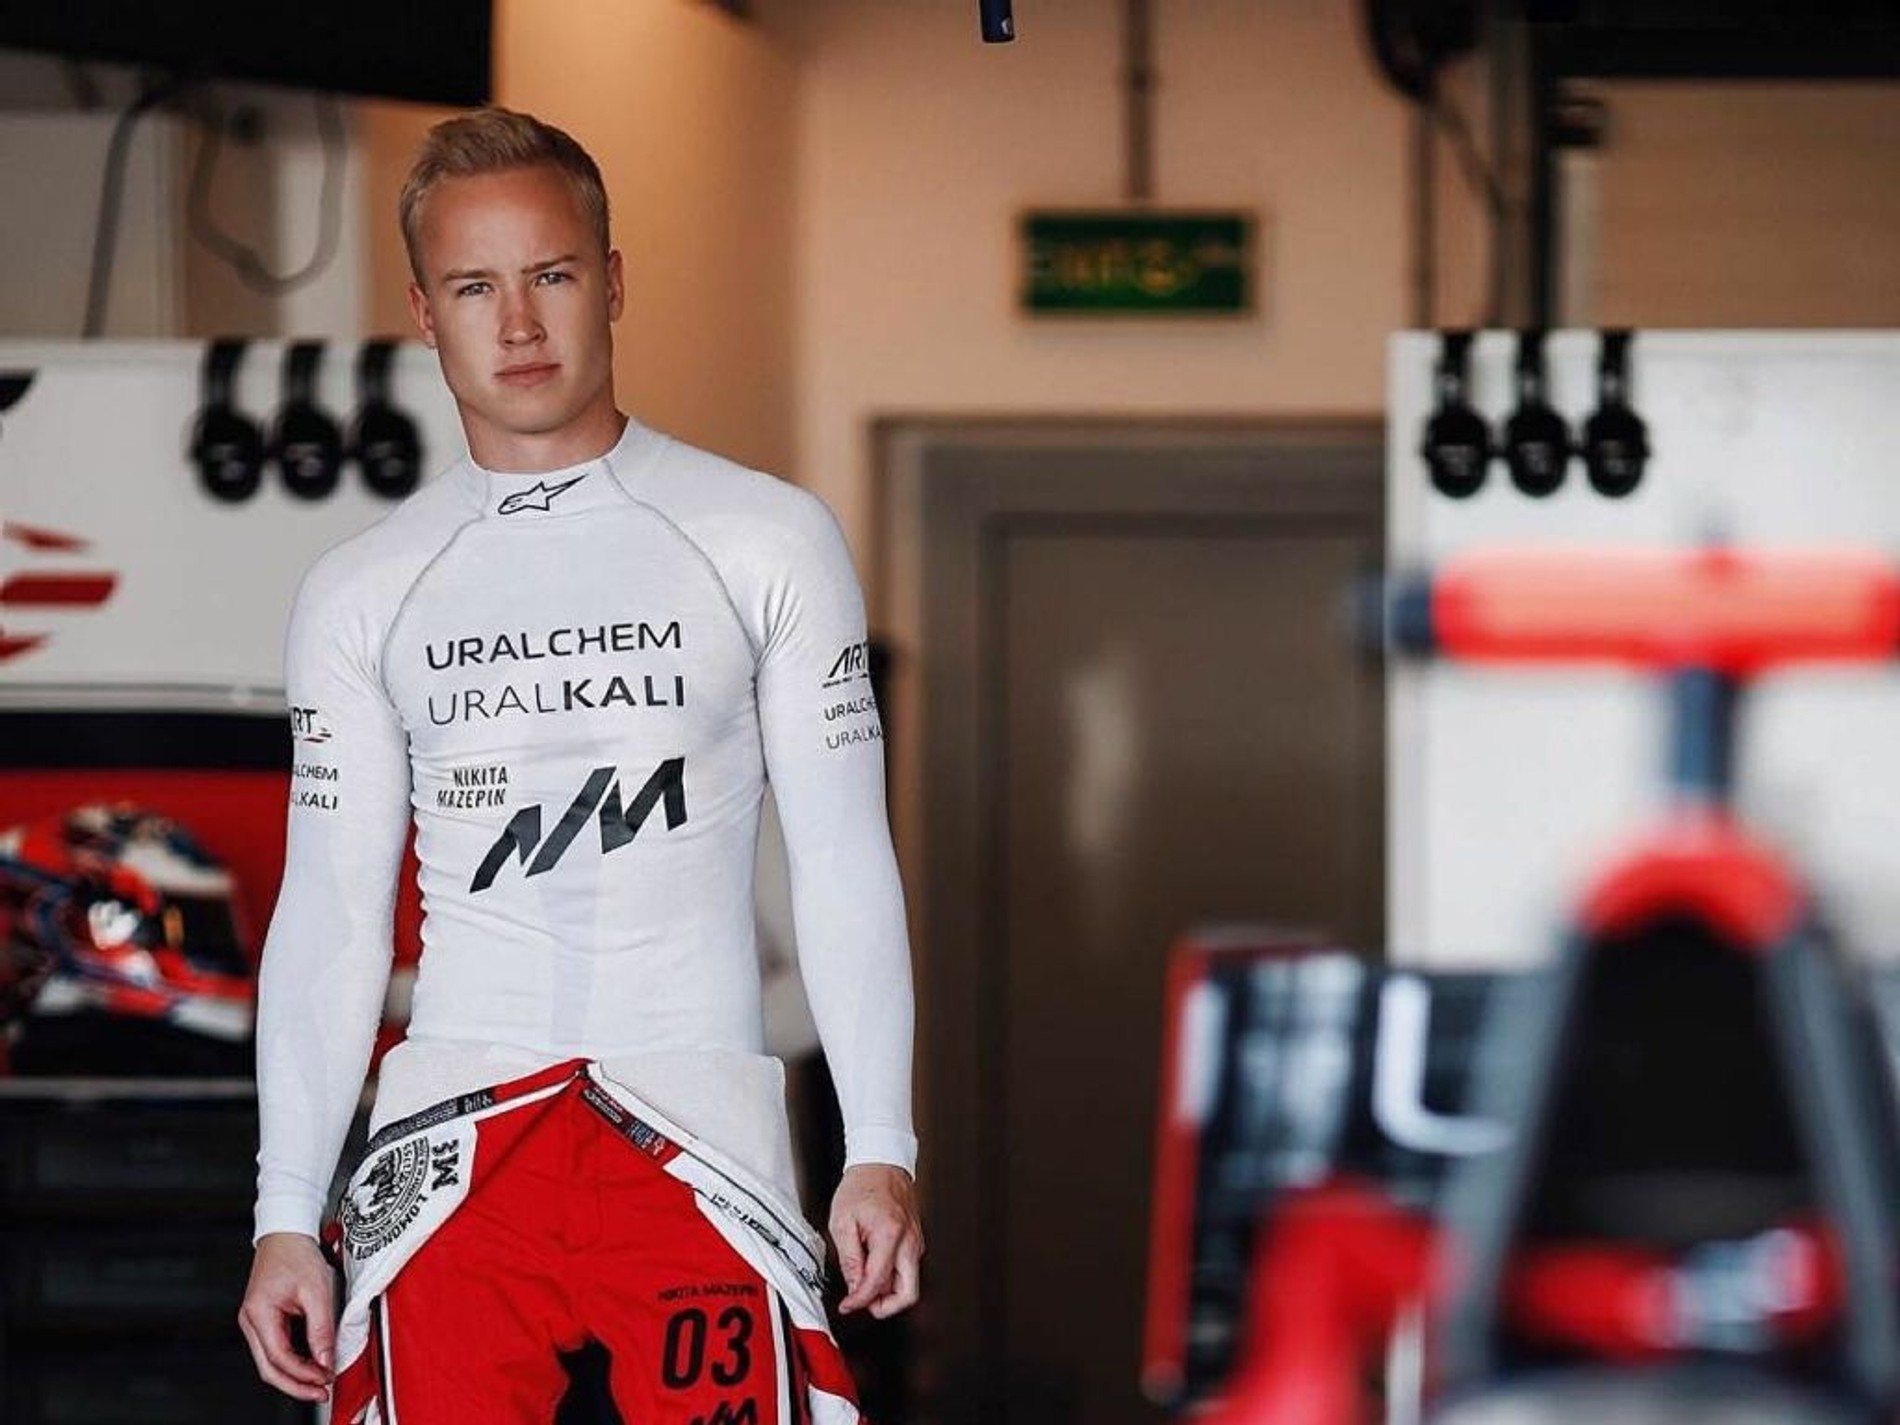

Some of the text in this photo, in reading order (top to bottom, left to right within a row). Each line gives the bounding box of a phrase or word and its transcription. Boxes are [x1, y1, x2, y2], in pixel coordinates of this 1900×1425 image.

[426, 621, 682, 671] URALCHEM
[428, 675, 685, 725] URALKALI
[436, 787, 506, 809] MAZEPIN
[453, 766, 508, 787] NIKITA
[662, 1304, 755, 1390] 03
